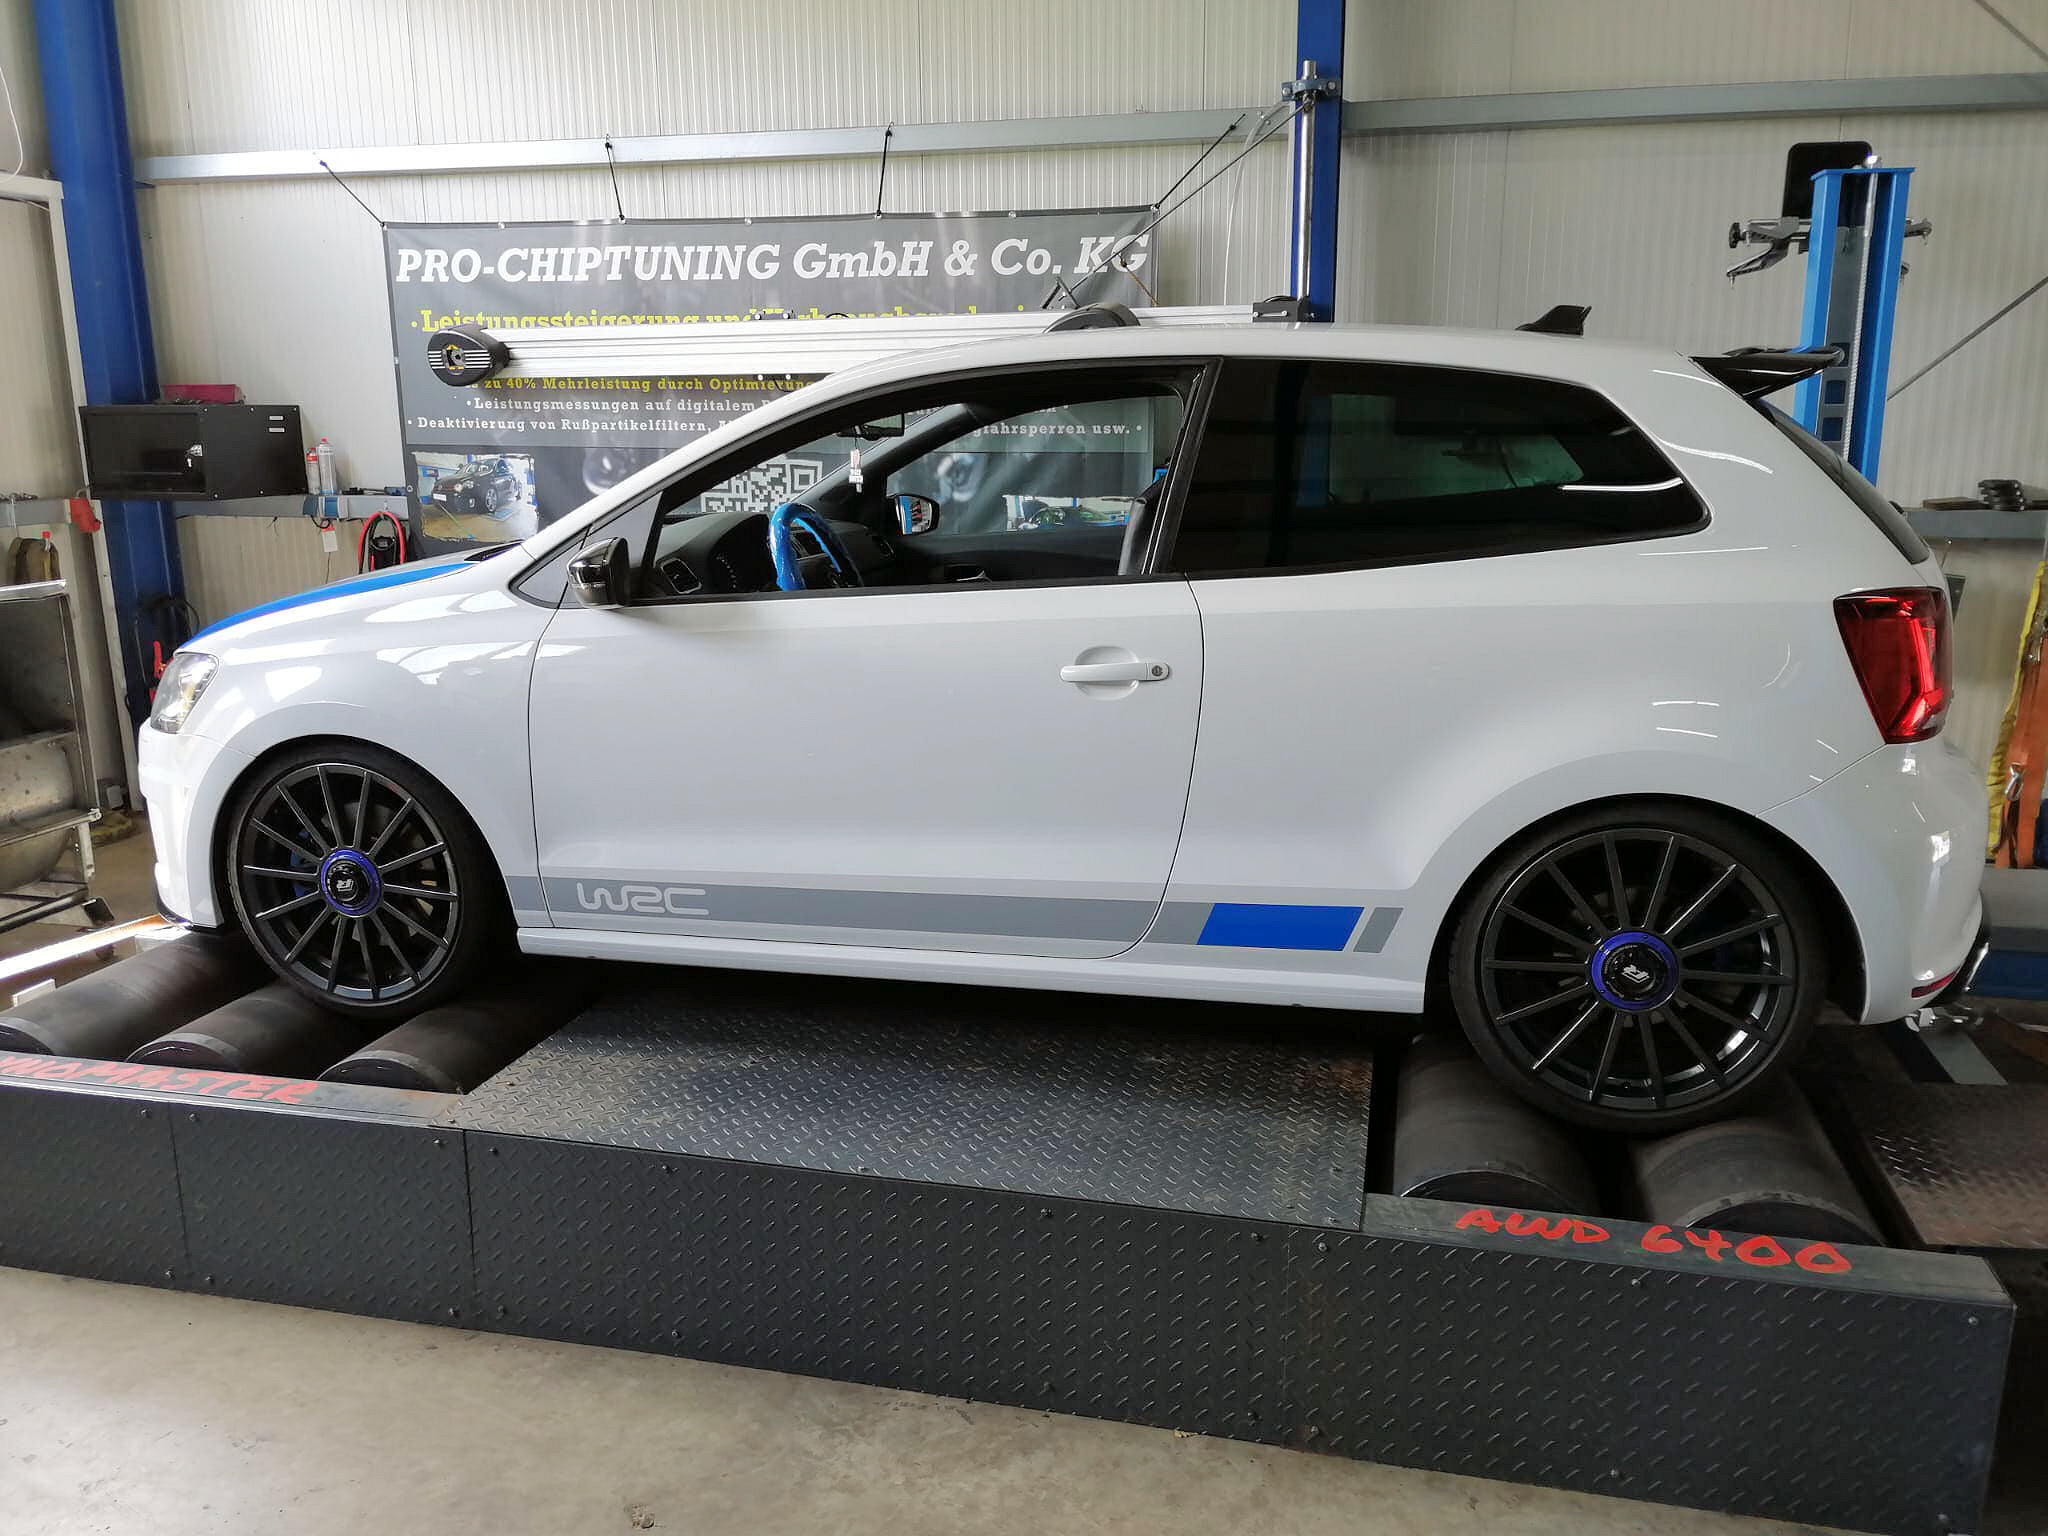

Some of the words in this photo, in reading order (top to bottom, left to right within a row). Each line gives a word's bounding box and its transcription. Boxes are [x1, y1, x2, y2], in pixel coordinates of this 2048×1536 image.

[395, 244, 780, 283] PRO-CHIPTUNING
[793, 240, 934, 279] GmbH
[943, 239, 978, 277] &
[990, 237, 1062, 276] Co.
[1073, 233, 1150, 274] KG
[484, 380, 501, 389] zu
[506, 378, 537, 390] 40%
[542, 378, 651, 393] Mehrleistung
[657, 377, 704, 391] durch
[473, 398, 640, 413] Leistungsmessungen
[645, 398, 673, 412] auf
[677, 398, 756, 414] digitalem
[417, 416, 526, 432] Deaktivierung
[530, 420, 556, 431] von
[1092, 423, 1131, 435] usw.
[576, 881, 710, 916] WRC
[1455, 1208, 1611, 1244] AWD
[1640, 1224, 1853, 1274] 6400
